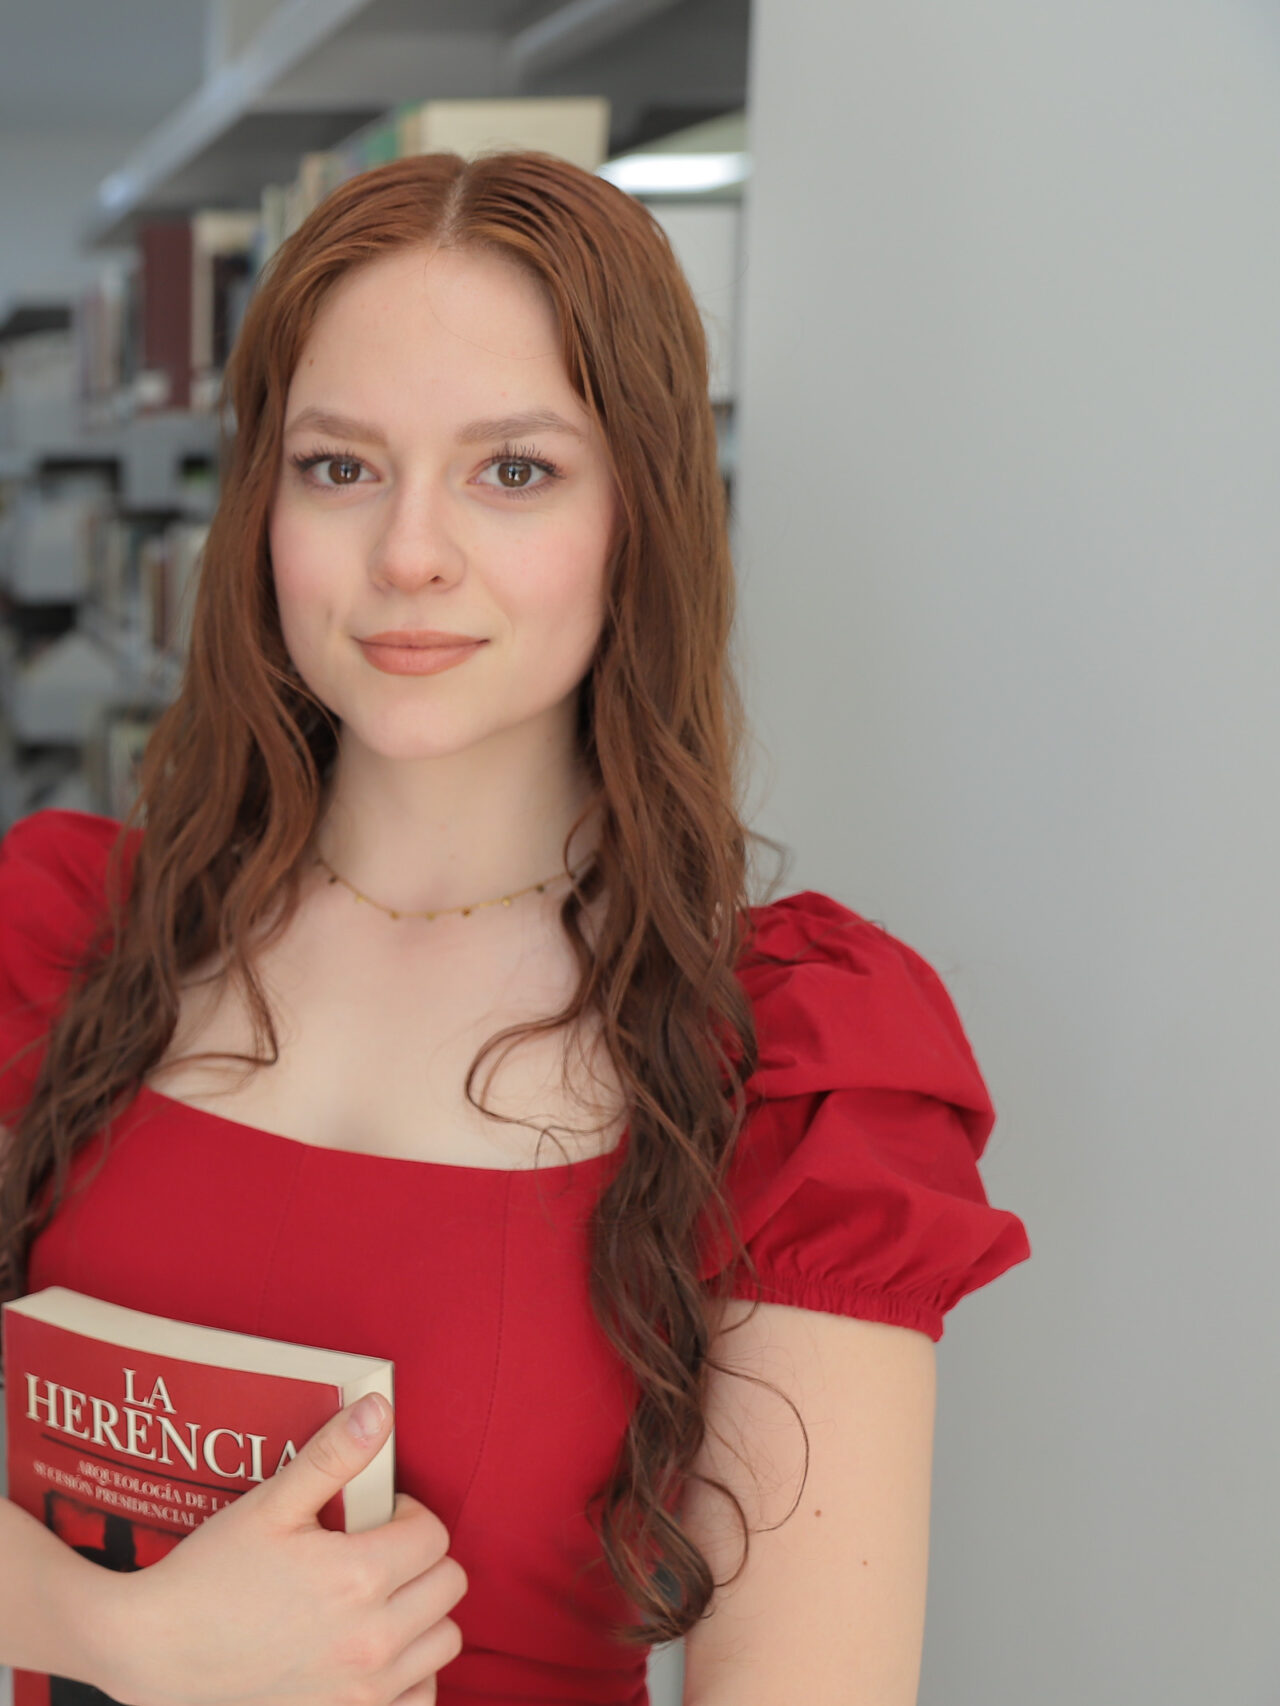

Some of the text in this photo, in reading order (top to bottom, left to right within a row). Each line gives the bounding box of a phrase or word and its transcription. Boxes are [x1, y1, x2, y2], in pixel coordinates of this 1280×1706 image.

[122, 1367, 177, 1415] LA
[32, 1460, 200, 1528] SUCESIÓN PRESIDENCIAL
[78, 1460, 182, 1504] ARQUEOLOGÍA
[185, 1491, 208, 1510] DE
